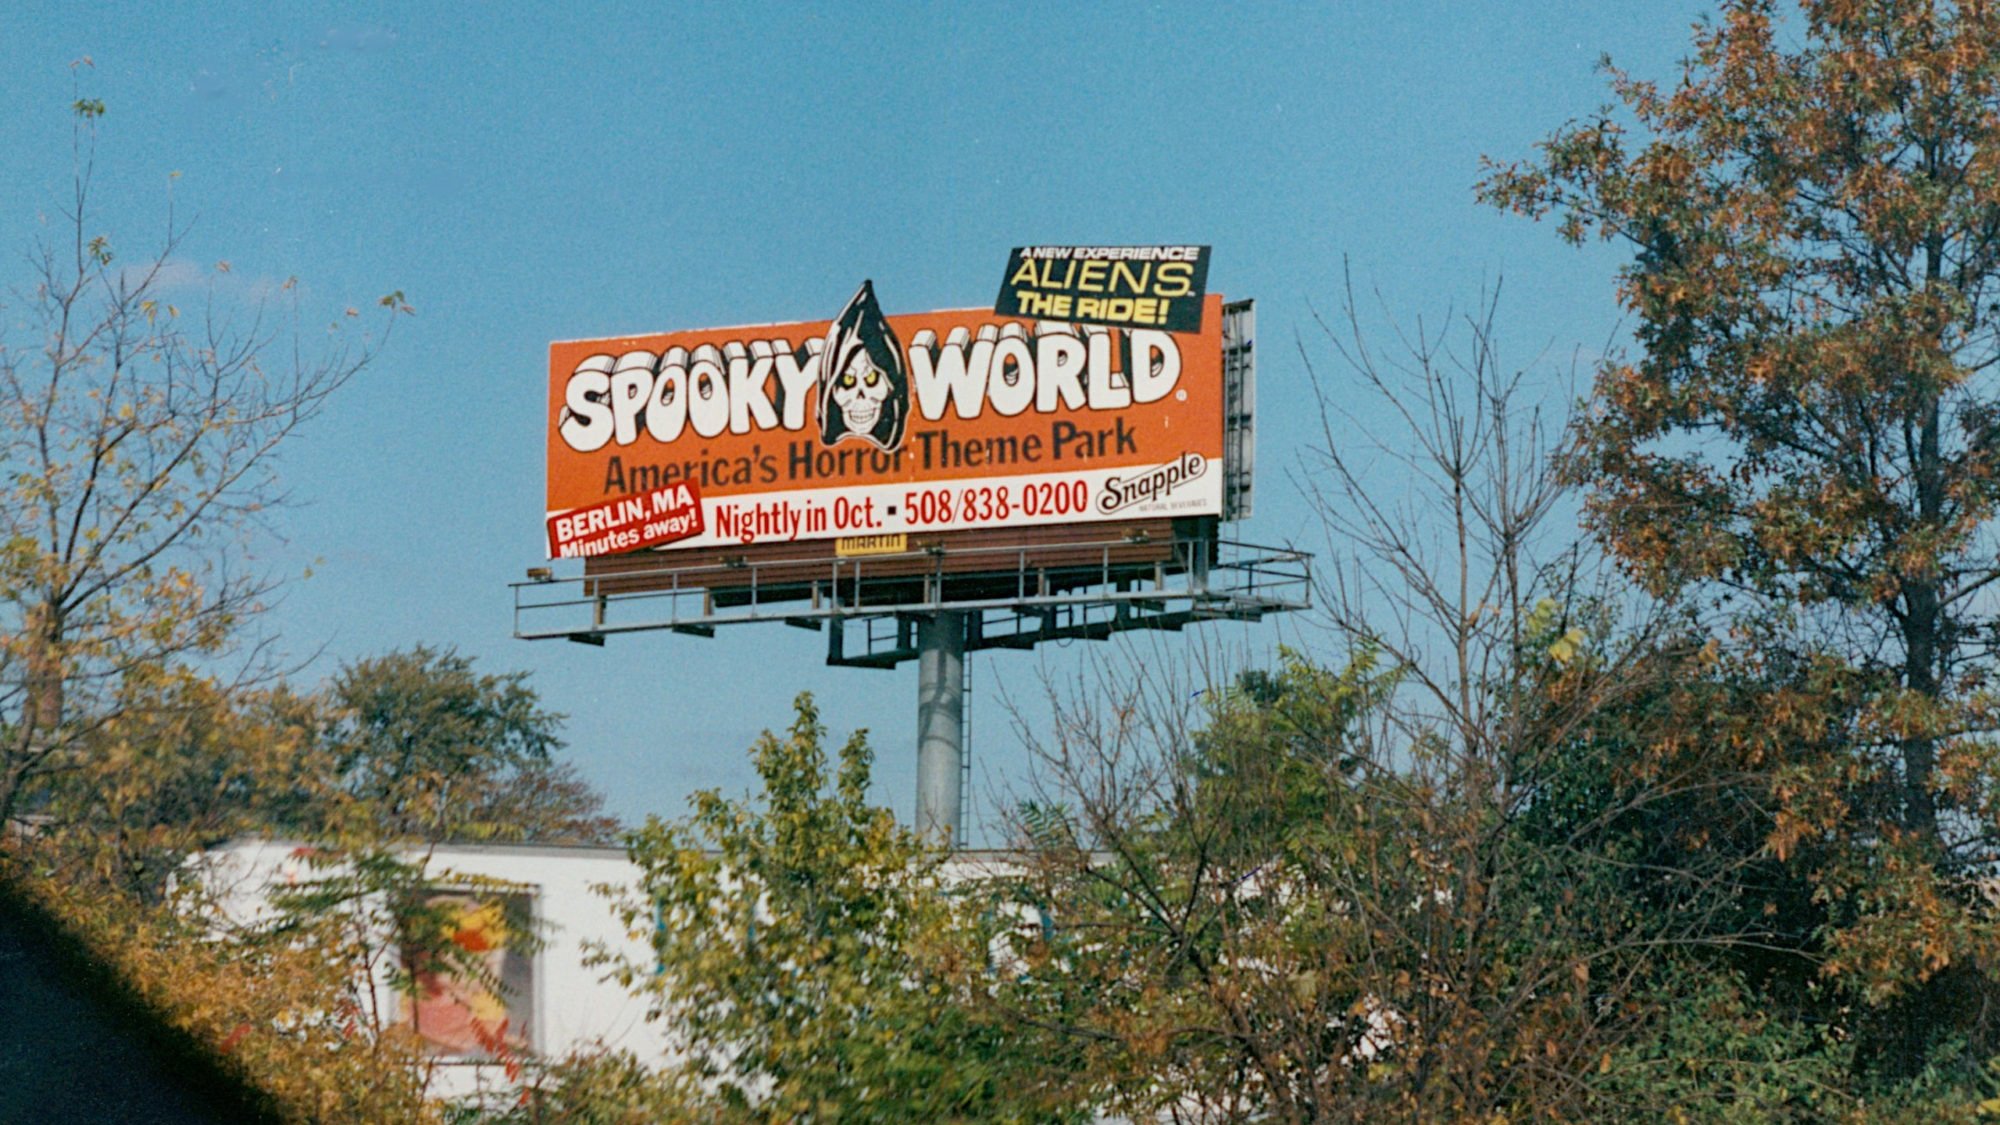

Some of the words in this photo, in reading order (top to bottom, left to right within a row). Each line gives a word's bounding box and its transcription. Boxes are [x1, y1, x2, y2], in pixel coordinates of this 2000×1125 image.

[1010, 258, 1194, 297] ALIENS
[1020, 247, 1032, 259] A
[1033, 247, 1071, 259] NEW
[1073, 246, 1200, 261] EXPERIENCE
[1016, 290, 1072, 317] THE
[1076, 298, 1170, 325] RIDE!
[559, 338, 825, 453] SPOOKY
[907, 323, 1182, 422] WORLD
[603, 445, 778, 495] America's
[789, 440, 907, 480] Horror
[916, 429, 1042, 470] Theme
[1052, 417, 1137, 460] Park
[1101, 452, 1201, 510] Snapple
[555, 497, 651, 543] BERLIN,
[652, 484, 694, 515] MA
[559, 528, 641, 559] Minutes
[643, 507, 697, 540] away!
[715, 501, 801, 545] Nightly
[806, 499, 827, 533] in
[834, 496, 882, 530] Oct.
[904, 479, 1088, 525] 508/838-0200
